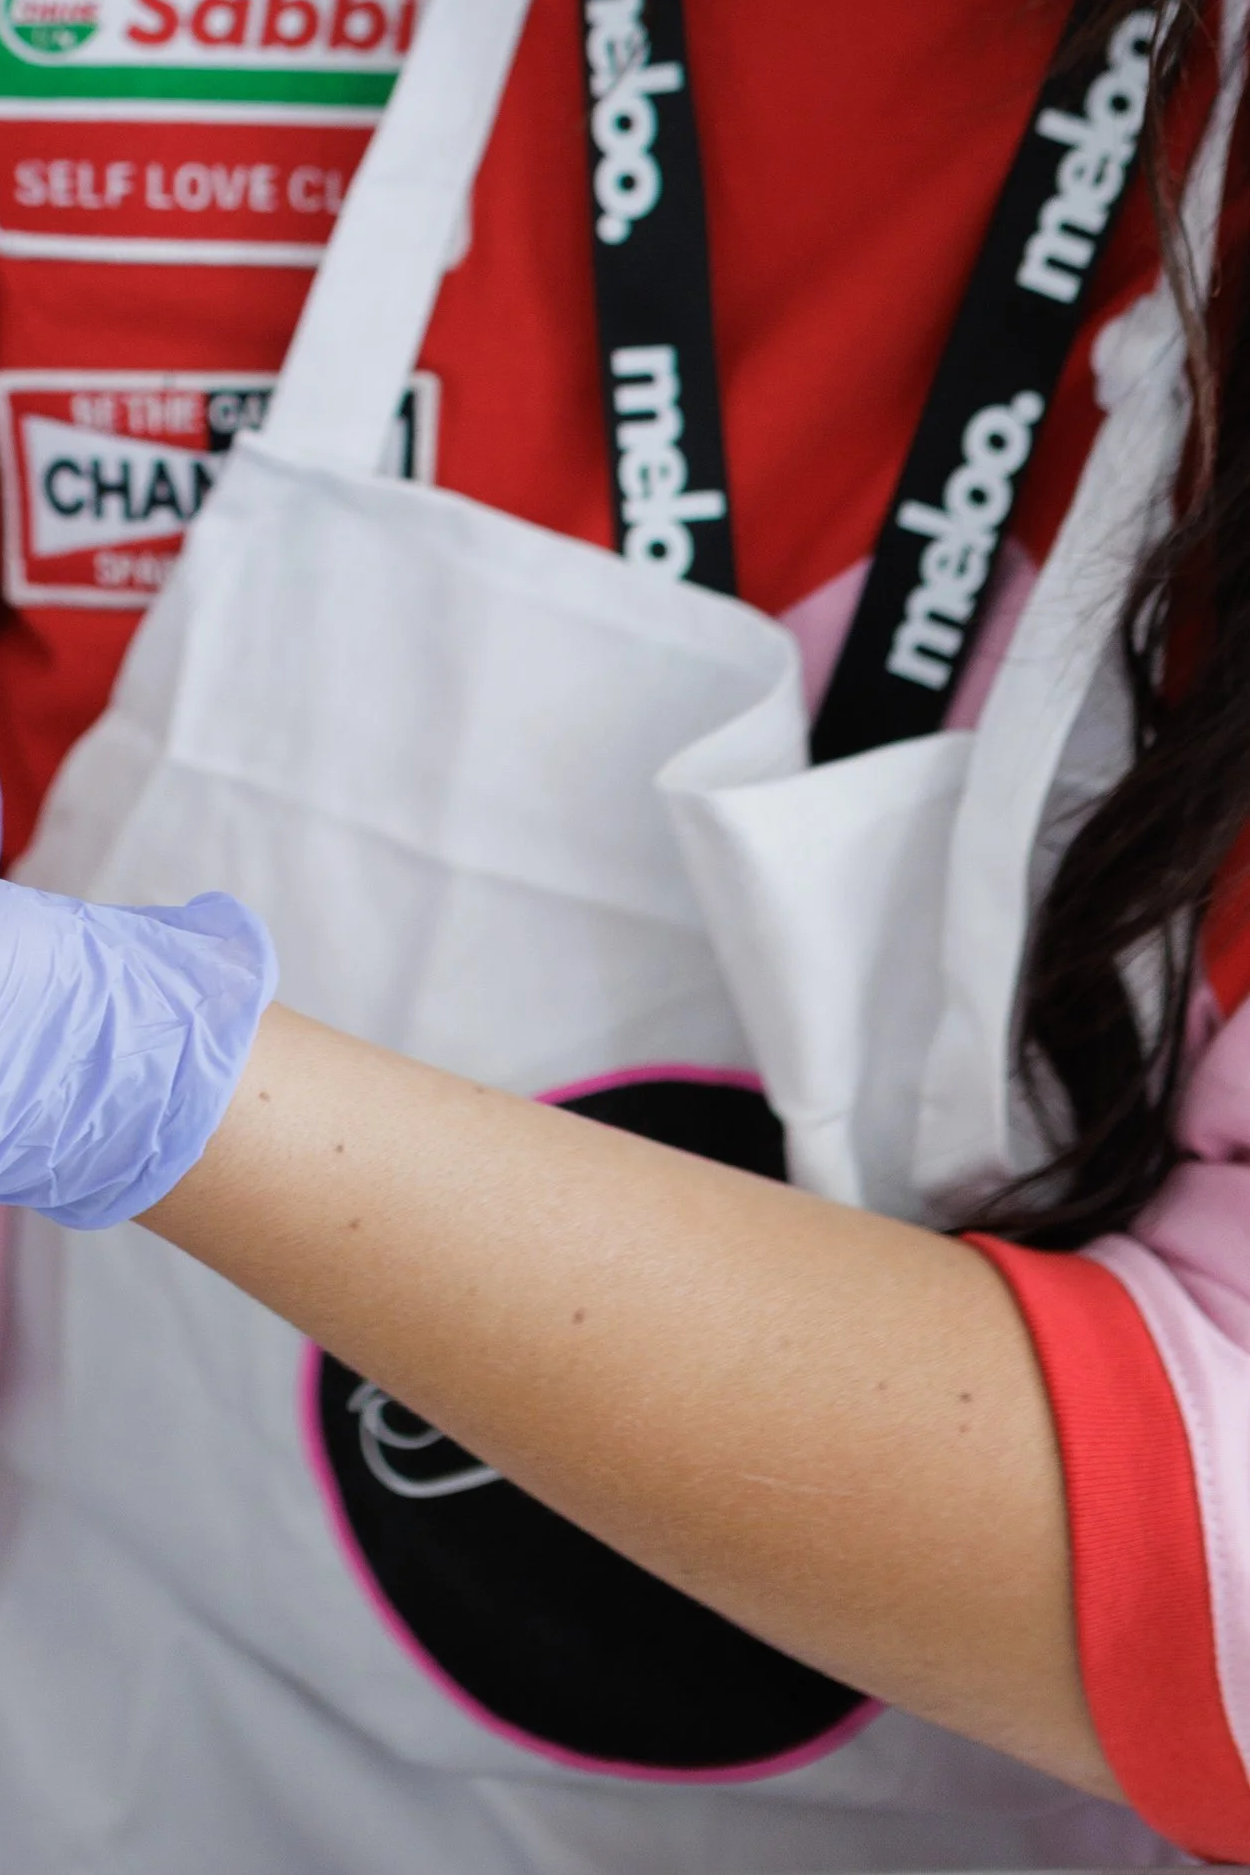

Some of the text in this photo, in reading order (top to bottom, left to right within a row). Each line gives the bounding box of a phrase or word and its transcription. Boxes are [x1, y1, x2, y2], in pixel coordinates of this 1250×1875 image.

[12, 157, 136, 211] SELF
[144, 161, 281, 215] LOVE
[884, 390, 1046, 693] meloo.
